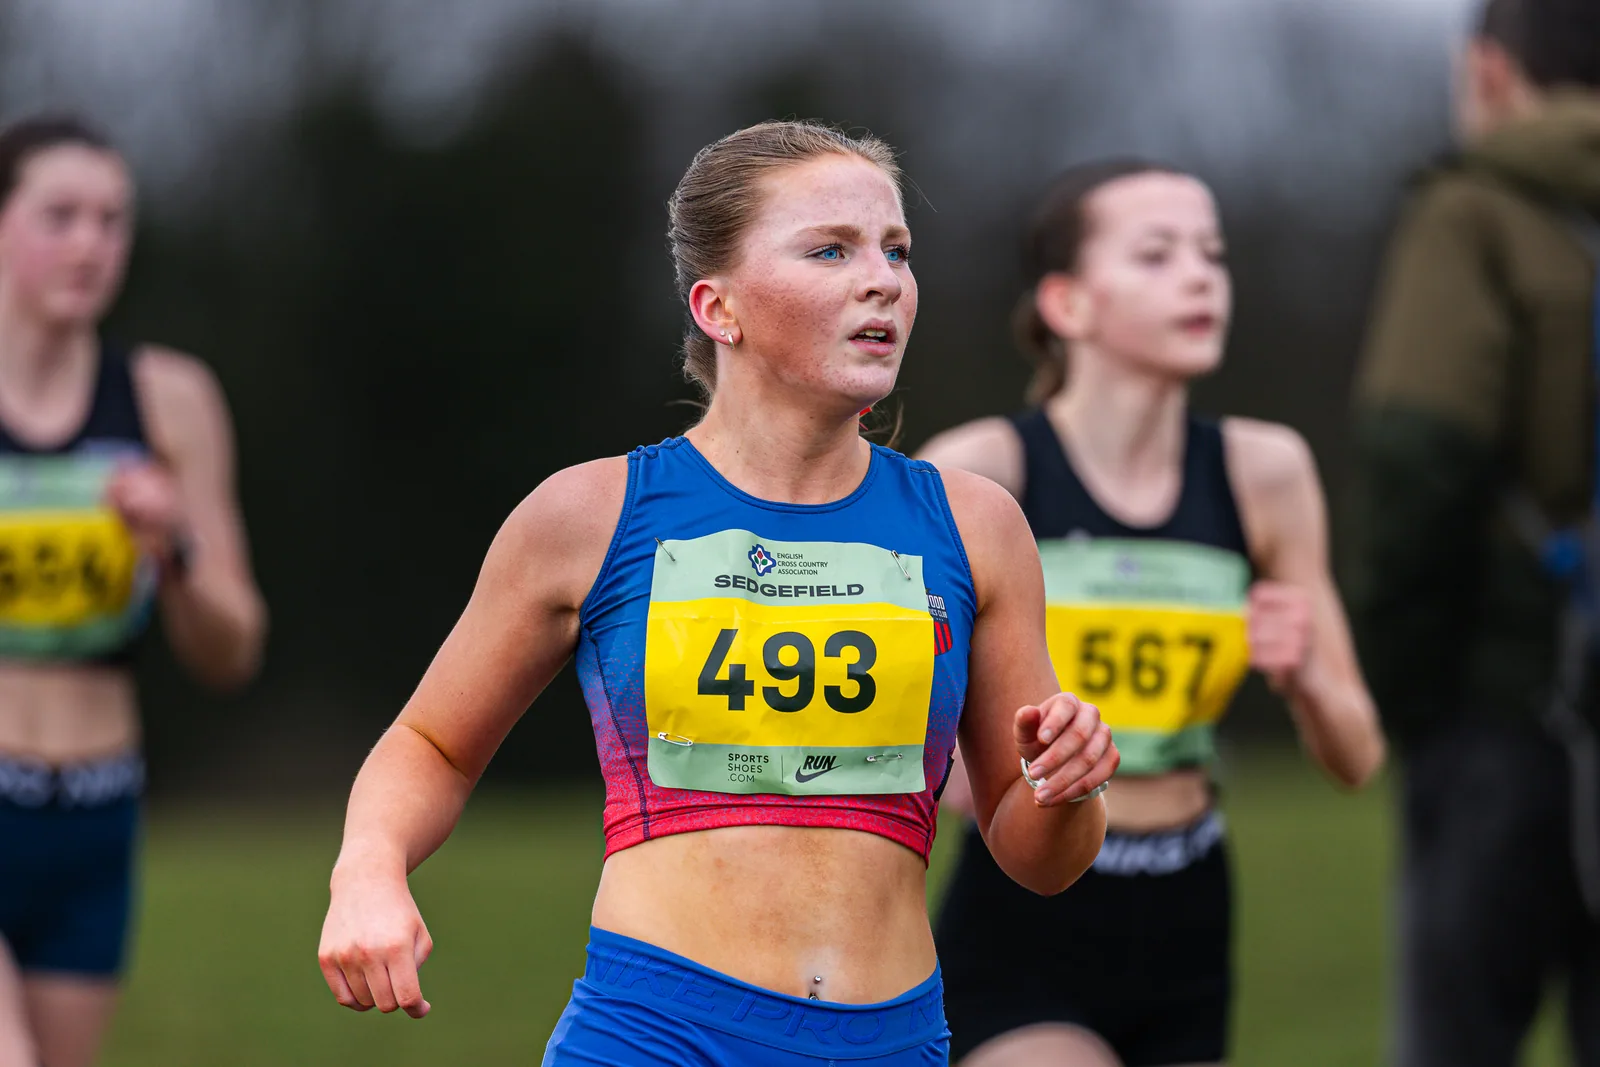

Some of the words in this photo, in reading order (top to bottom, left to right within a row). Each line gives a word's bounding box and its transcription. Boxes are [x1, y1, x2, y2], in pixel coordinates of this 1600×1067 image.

[714, 574, 865, 597] SEDGEFIELD
[697, 628, 877, 714] 493
[1077, 627, 1216, 703] 567
[728, 753, 769, 763] SPORTS
[803, 755, 836, 770] RUN
[728, 763, 763, 773] SHOES
[728, 773, 755, 782] .COM
[585, 946, 728, 1013] NIKE
[731, 989, 887, 1046] PRO
